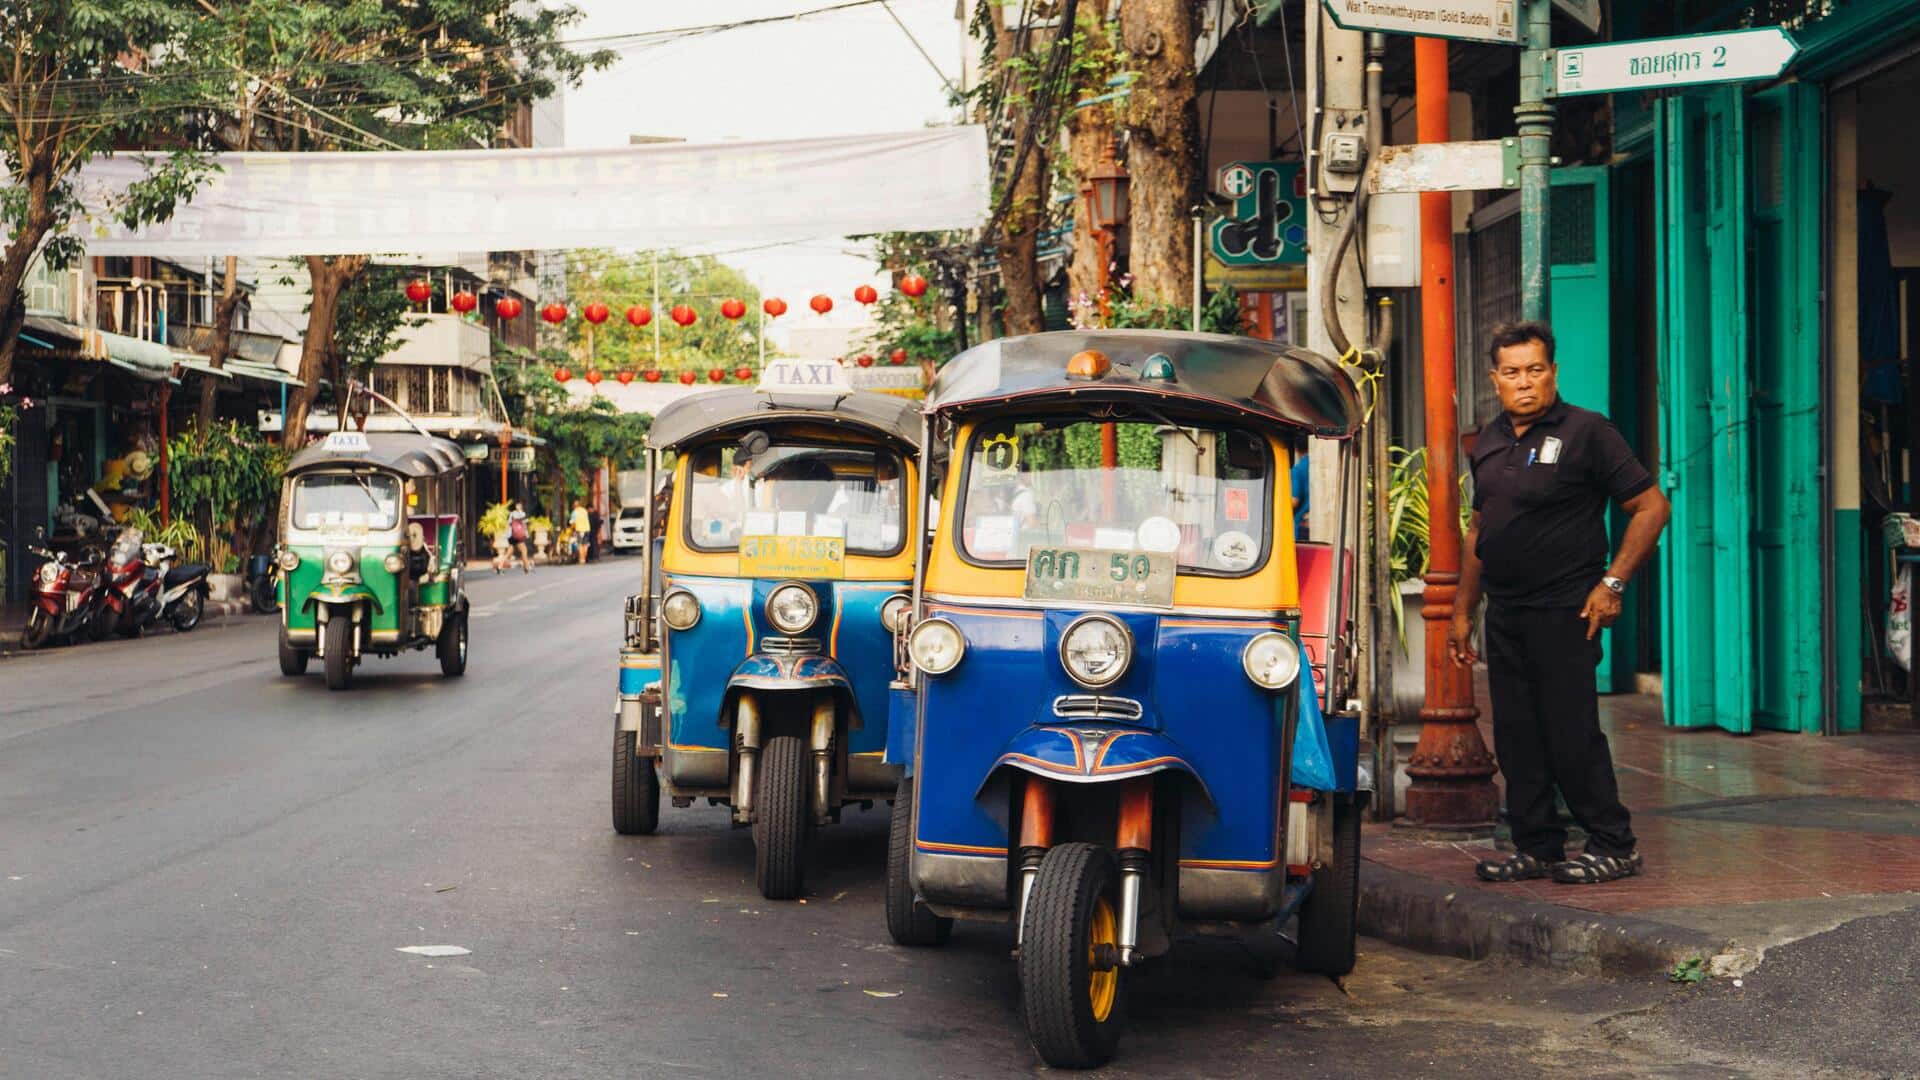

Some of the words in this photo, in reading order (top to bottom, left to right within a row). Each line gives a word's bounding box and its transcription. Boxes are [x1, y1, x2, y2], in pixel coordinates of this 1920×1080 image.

[1345, 0, 1361, 13] Wat
[1438, 7, 1458, 24] (Gold
[1711, 46, 1726, 67] 2
[775, 363, 834, 385] TAXI
[331, 434, 360, 446] TAXI
[1110, 552, 1151, 582] 50
